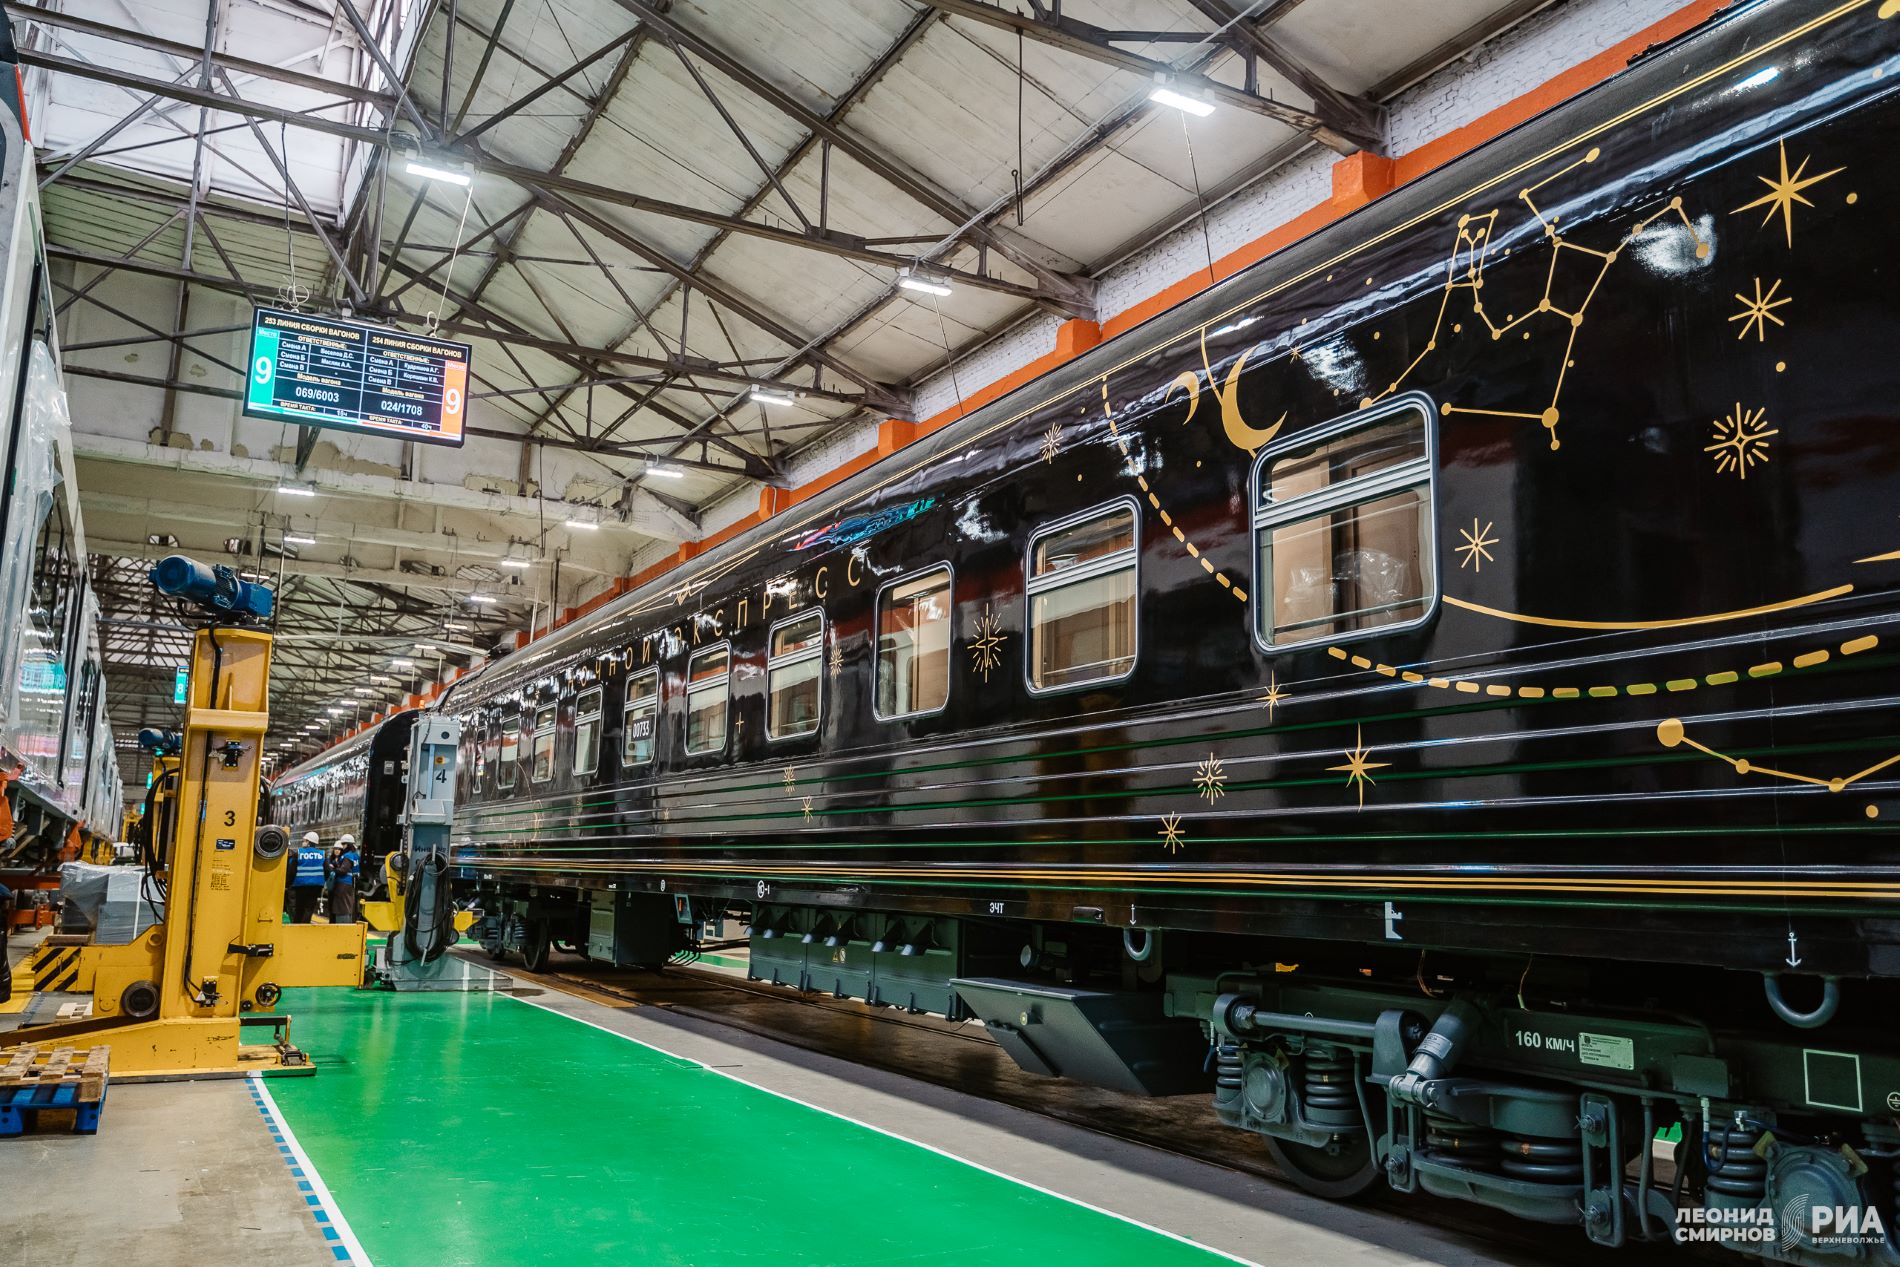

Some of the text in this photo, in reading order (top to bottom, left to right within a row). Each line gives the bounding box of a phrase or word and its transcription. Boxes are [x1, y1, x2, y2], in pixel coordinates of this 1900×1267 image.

[277, 318, 300, 330] ЛИНИЯ
[301, 323, 328, 335] СБОРКИ
[328, 328, 360, 340] ВАГОНОВ
[281, 341, 307, 351] Смена А
[372, 336, 462, 358] 254 ЛИНИЯ СБОРКИ ВАГОНОВ
[280, 351, 300, 361] Смена
[369, 356, 394, 367] Смена А
[255, 356, 272, 384] 9
[279, 361, 299, 370] Смена
[369, 366, 388, 375] Смена
[297, 373, 342, 386] Модель вагона
[368, 375, 387, 384] Смена
[295, 386, 340, 403] 069/6003
[382, 386, 425, 400] Модель вагона
[381, 400, 423, 416] 024/1708
[445, 388, 461, 415] 9
[435, 768, 447, 784] 4
[223, 810, 236, 827] 3
[299, 852, 323, 860] ГОСТЬ
[1515, 1030, 1541, 1048] 160
